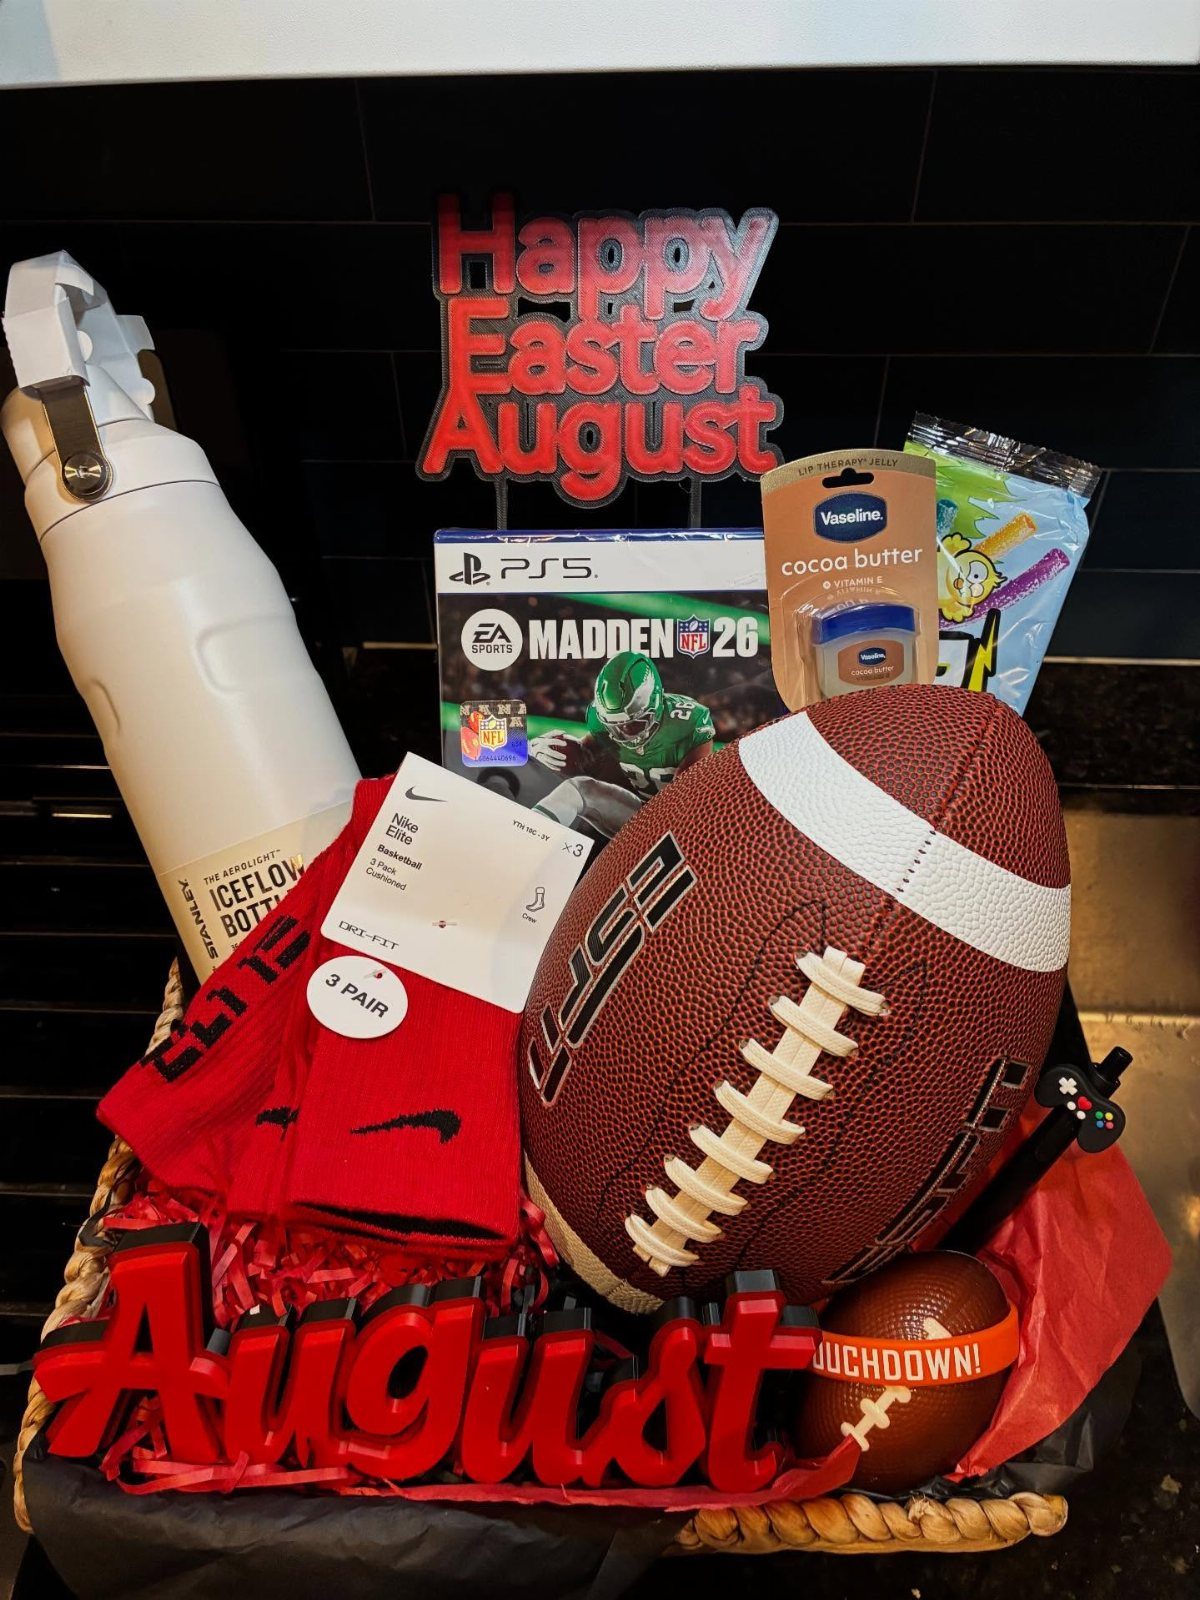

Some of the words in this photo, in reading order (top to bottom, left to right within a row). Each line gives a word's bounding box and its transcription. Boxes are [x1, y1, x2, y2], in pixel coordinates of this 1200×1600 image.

[437, 192, 773, 321] Happy
[447, 299, 762, 396] Easter
[422, 385, 779, 502] August
[798, 465, 814, 476] LIP
[869, 458, 898, 467] JELLY
[500, 557, 593, 579] PS5
[781, 555, 848, 576] cocoa
[854, 547, 923, 569] butter
[833, 577, 874, 589] VITAMIN
[876, 576, 884, 584] E
[472, 623, 512, 644] EA
[529, 618, 674, 660] MADDEN
[680, 632, 708, 651] NFL
[712, 616, 759, 658] 26
[471, 644, 513, 654] SPORTS
[850, 668, 873, 676] cocoa
[670, 701, 695, 721] 26
[482, 730, 505, 745] NFL
[391, 812, 419, 834] Nike
[512, 819, 526, 831] YTH
[385, 824, 413, 846] Elite
[370, 858, 377, 866] 3
[377, 861, 397, 876] Pack
[377, 844, 423, 870] Basketball
[203, 873, 221, 886] THE
[366, 867, 407, 891] Cushioned
[220, 894, 282, 938] BOTT
[521, 912, 538, 924] Crew
[338, 920, 400, 950] DRI-FIT
[325, 973, 341, 987] 3
[340, 982, 389, 1018] PAIR
[33, 1232, 822, 1494] August
[812, 1342, 981, 1381] OUCHDOWN!
